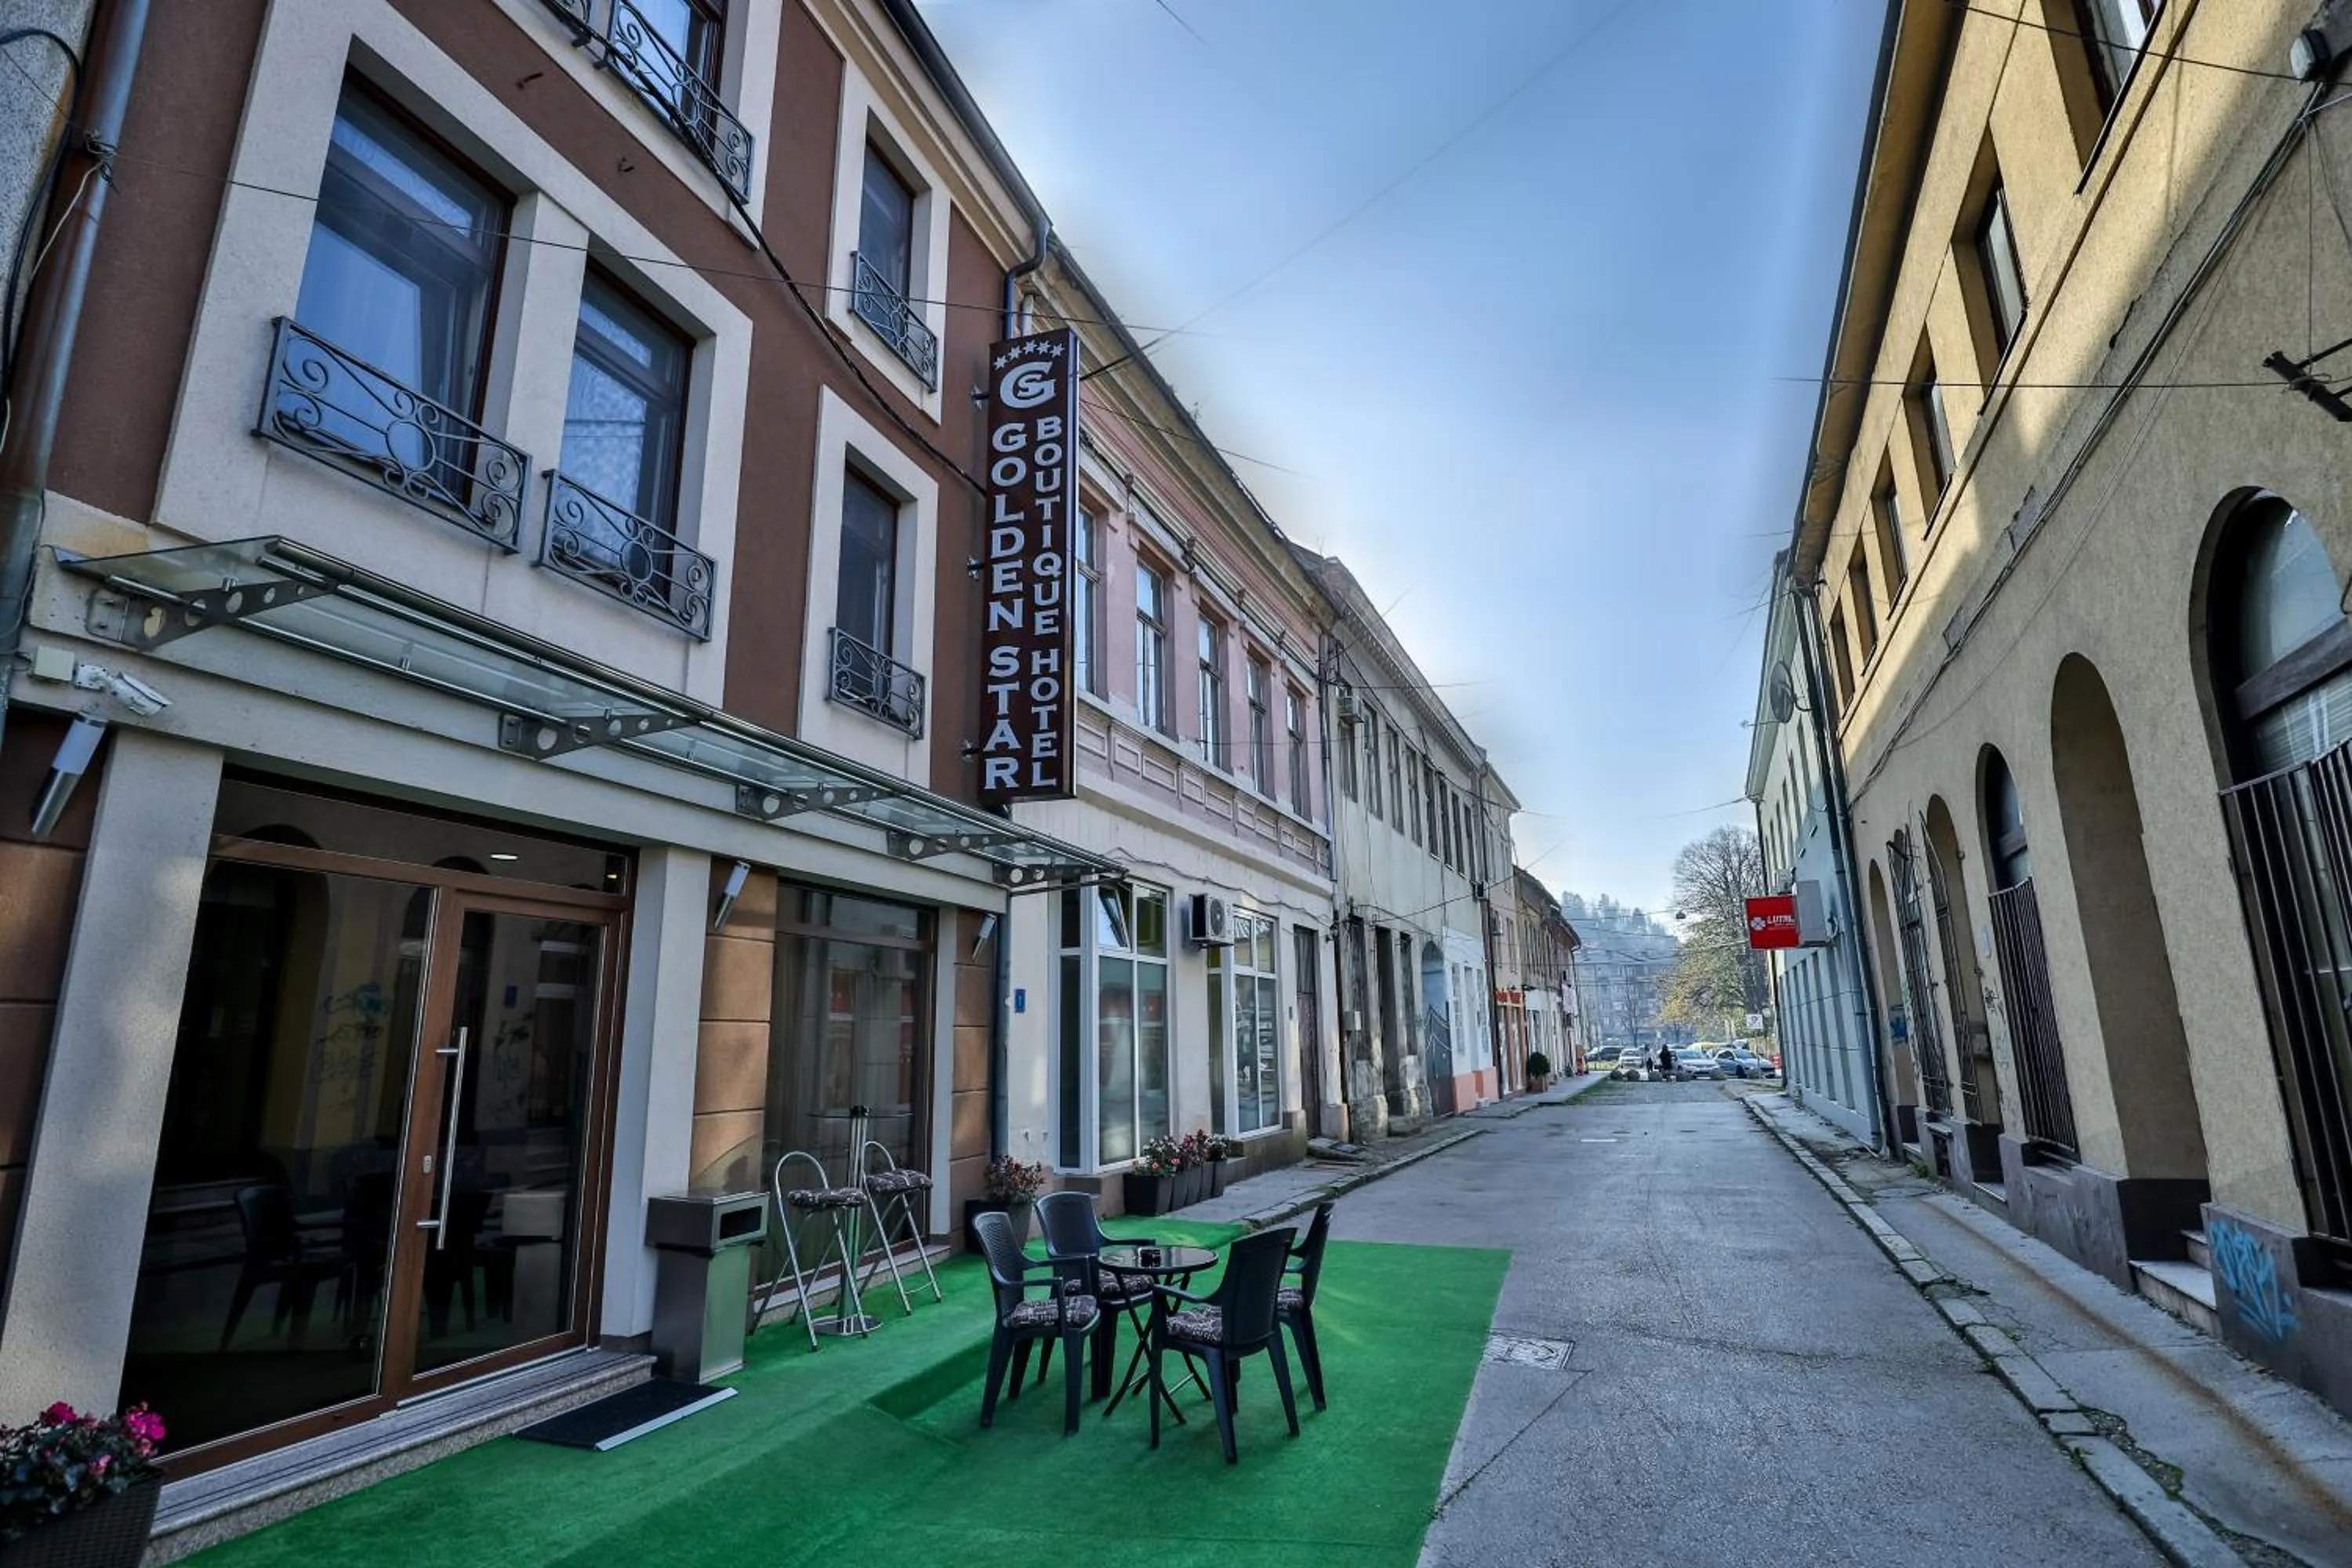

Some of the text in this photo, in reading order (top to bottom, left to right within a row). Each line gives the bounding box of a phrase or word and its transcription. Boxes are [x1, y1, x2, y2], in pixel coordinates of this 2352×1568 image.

[983, 423, 1027, 789] GOLDEN STAR
[1030, 416, 1062, 787] BOUTIQUE HOTEL
